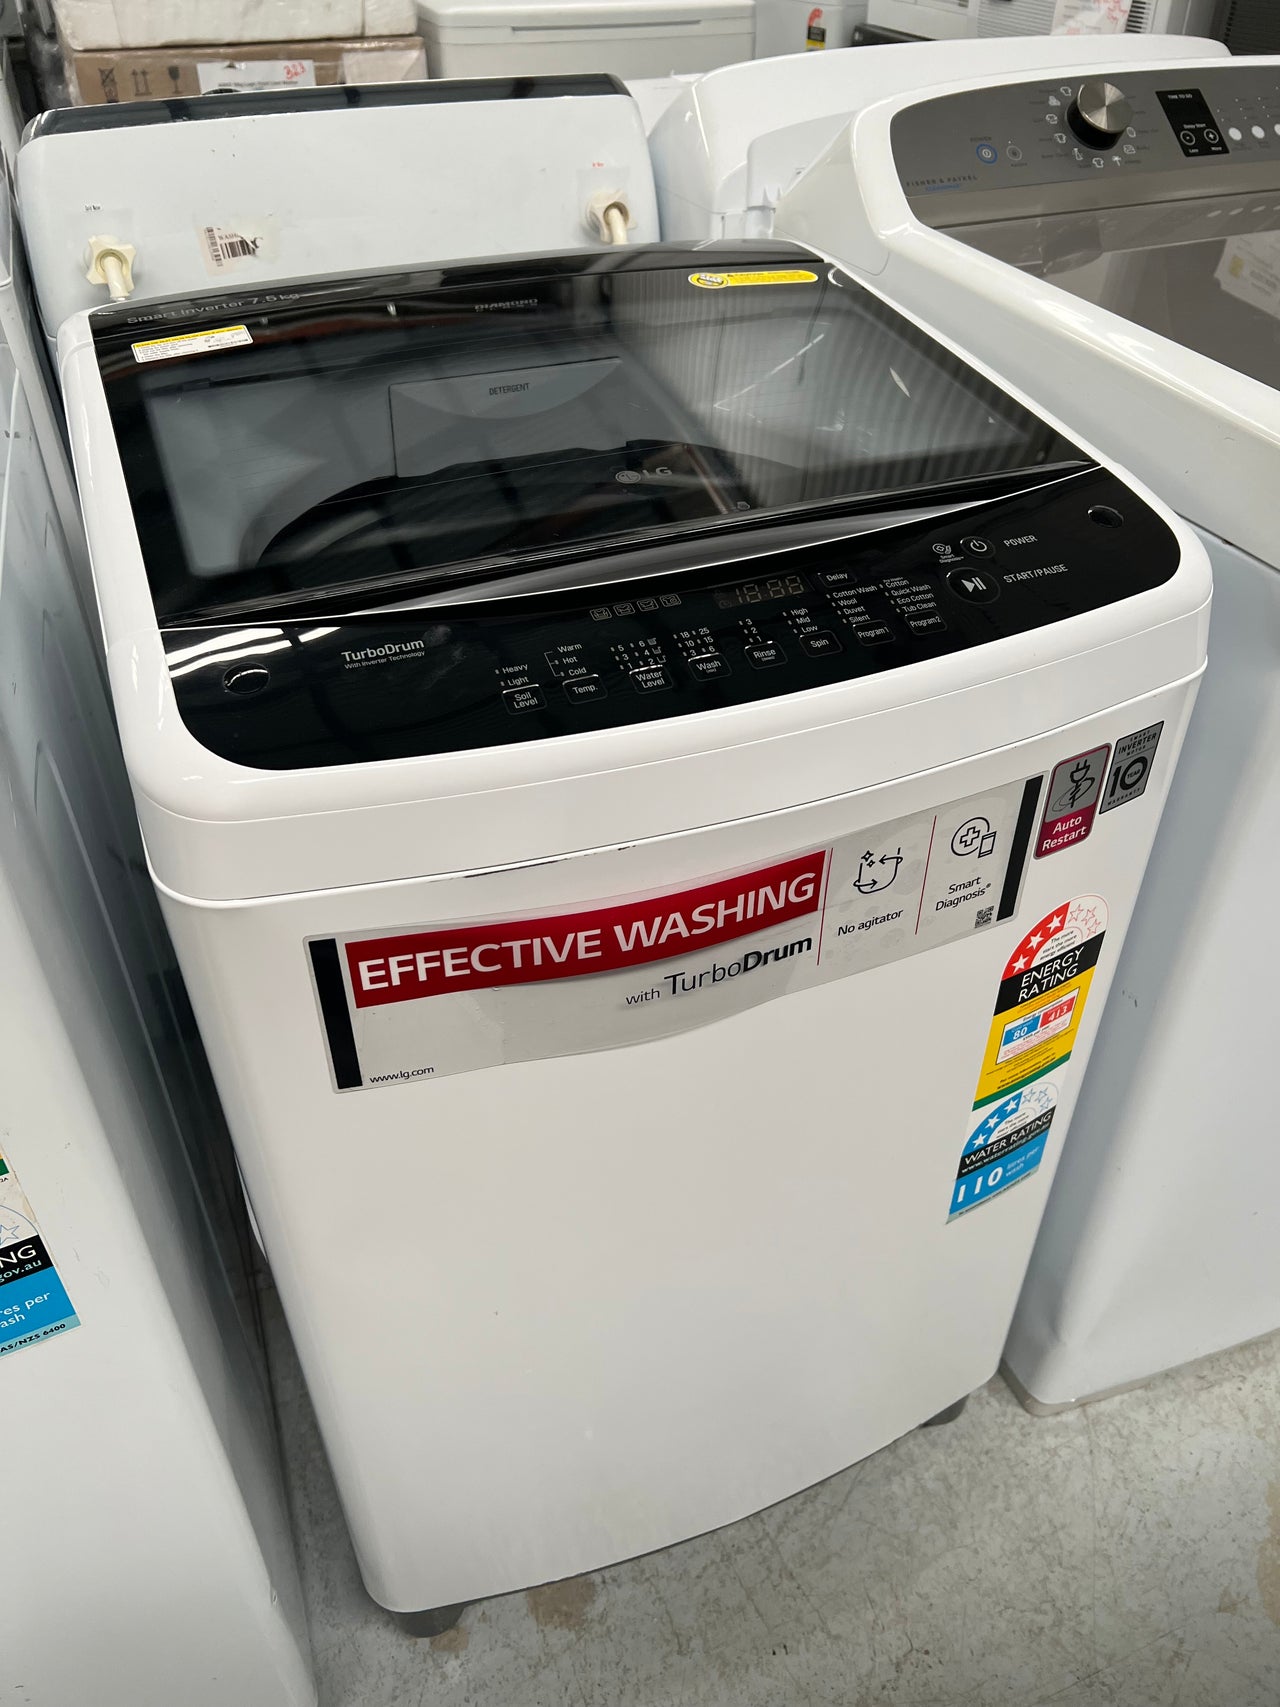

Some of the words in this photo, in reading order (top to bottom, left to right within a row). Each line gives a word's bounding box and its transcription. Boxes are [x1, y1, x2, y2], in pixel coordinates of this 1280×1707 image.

[906, 178, 937, 187] FISHER
[947, 175, 978, 183] PAYKEL
[127, 309, 177, 324] Smart
[250, 293, 277, 305] 7.5
[489, 382, 530, 396] DETERGENT
[1003, 534, 1038, 547] POWER
[826, 573, 848, 582] Delay
[1003, 563, 1069, 583] START/PAUSE
[885, 579, 909, 589] Cotton
[833, 589, 858, 599] Cotton
[855, 585, 878, 595] Wash
[891, 588, 911, 598] Quick
[910, 583, 932, 593] Wash
[837, 597, 858, 607] Wool
[896, 597, 911, 606] Eco
[910, 592, 935, 602] Cotton
[790, 607, 809, 617] High
[843, 605, 866, 615] Duvet
[902, 605, 917, 613] Tub
[916, 601, 937, 611] Clean
[745, 618, 753, 626] 3
[796, 616, 811, 625] Mid
[849, 614, 871, 624] Silent
[680, 631, 691, 639] 18
[699, 627, 710, 635] 25
[801, 625, 818, 634] Low
[617, 644, 625, 652] 5
[638, 640, 646, 648] 6
[684, 640, 695, 648] 10
[703, 636, 714, 644] 15
[810, 639, 829, 649] Spin
[341, 640, 425, 662] TurboDrum
[557, 643, 583, 654] Warm
[689, 649, 697, 657] 3
[753, 649, 777, 660] Rinse
[344, 661, 361, 670] With
[361, 657, 388, 668] Inverter
[389, 650, 426, 663] Technology
[562, 656, 578, 665] Hot
[622, 653, 629, 661] 3
[502, 663, 529, 675] Heavy
[696, 660, 722, 671] Wash
[568, 667, 587, 677] Cold
[635, 670, 663, 682] Water
[507, 676, 530, 687] Light
[641, 677, 666, 689] Level
[572, 684, 599, 695] Temp.
[514, 691, 532, 702] Soil
[513, 698, 539, 710] Level
[1118, 732, 1157, 755] INVERTER
[1108, 755, 1148, 799] 10
[1052, 815, 1083, 835] Auto
[1041, 825, 1088, 852] Restart
[948, 876, 982, 895] Smart
[837, 922, 855, 937] No
[857, 909, 904, 932] agitator
[358, 928, 602, 991] EFFECTIVE
[613, 872, 816, 953] WASHING
[625, 987, 660, 1006] with
[663, 937, 812, 995] TurboDrum
[1021, 946, 1085, 988] ENERGY
[1018, 963, 1079, 1003] RATING
[1048, 1005, 1068, 1022] 413
[1013, 1026, 1028, 1041] 80
[369, 1065, 435, 1084] www.lg.com
[965, 1138, 1008, 1165] WATER
[1009, 1111, 1052, 1143] RATING
[957, 1166, 1004, 1204] 110
[24, 1292, 51, 1311] per
[0, 1313, 26, 1328] ash
[0, 1333, 41, 1354] AS/NZS
[42, 1323, 67, 1337] 6400
